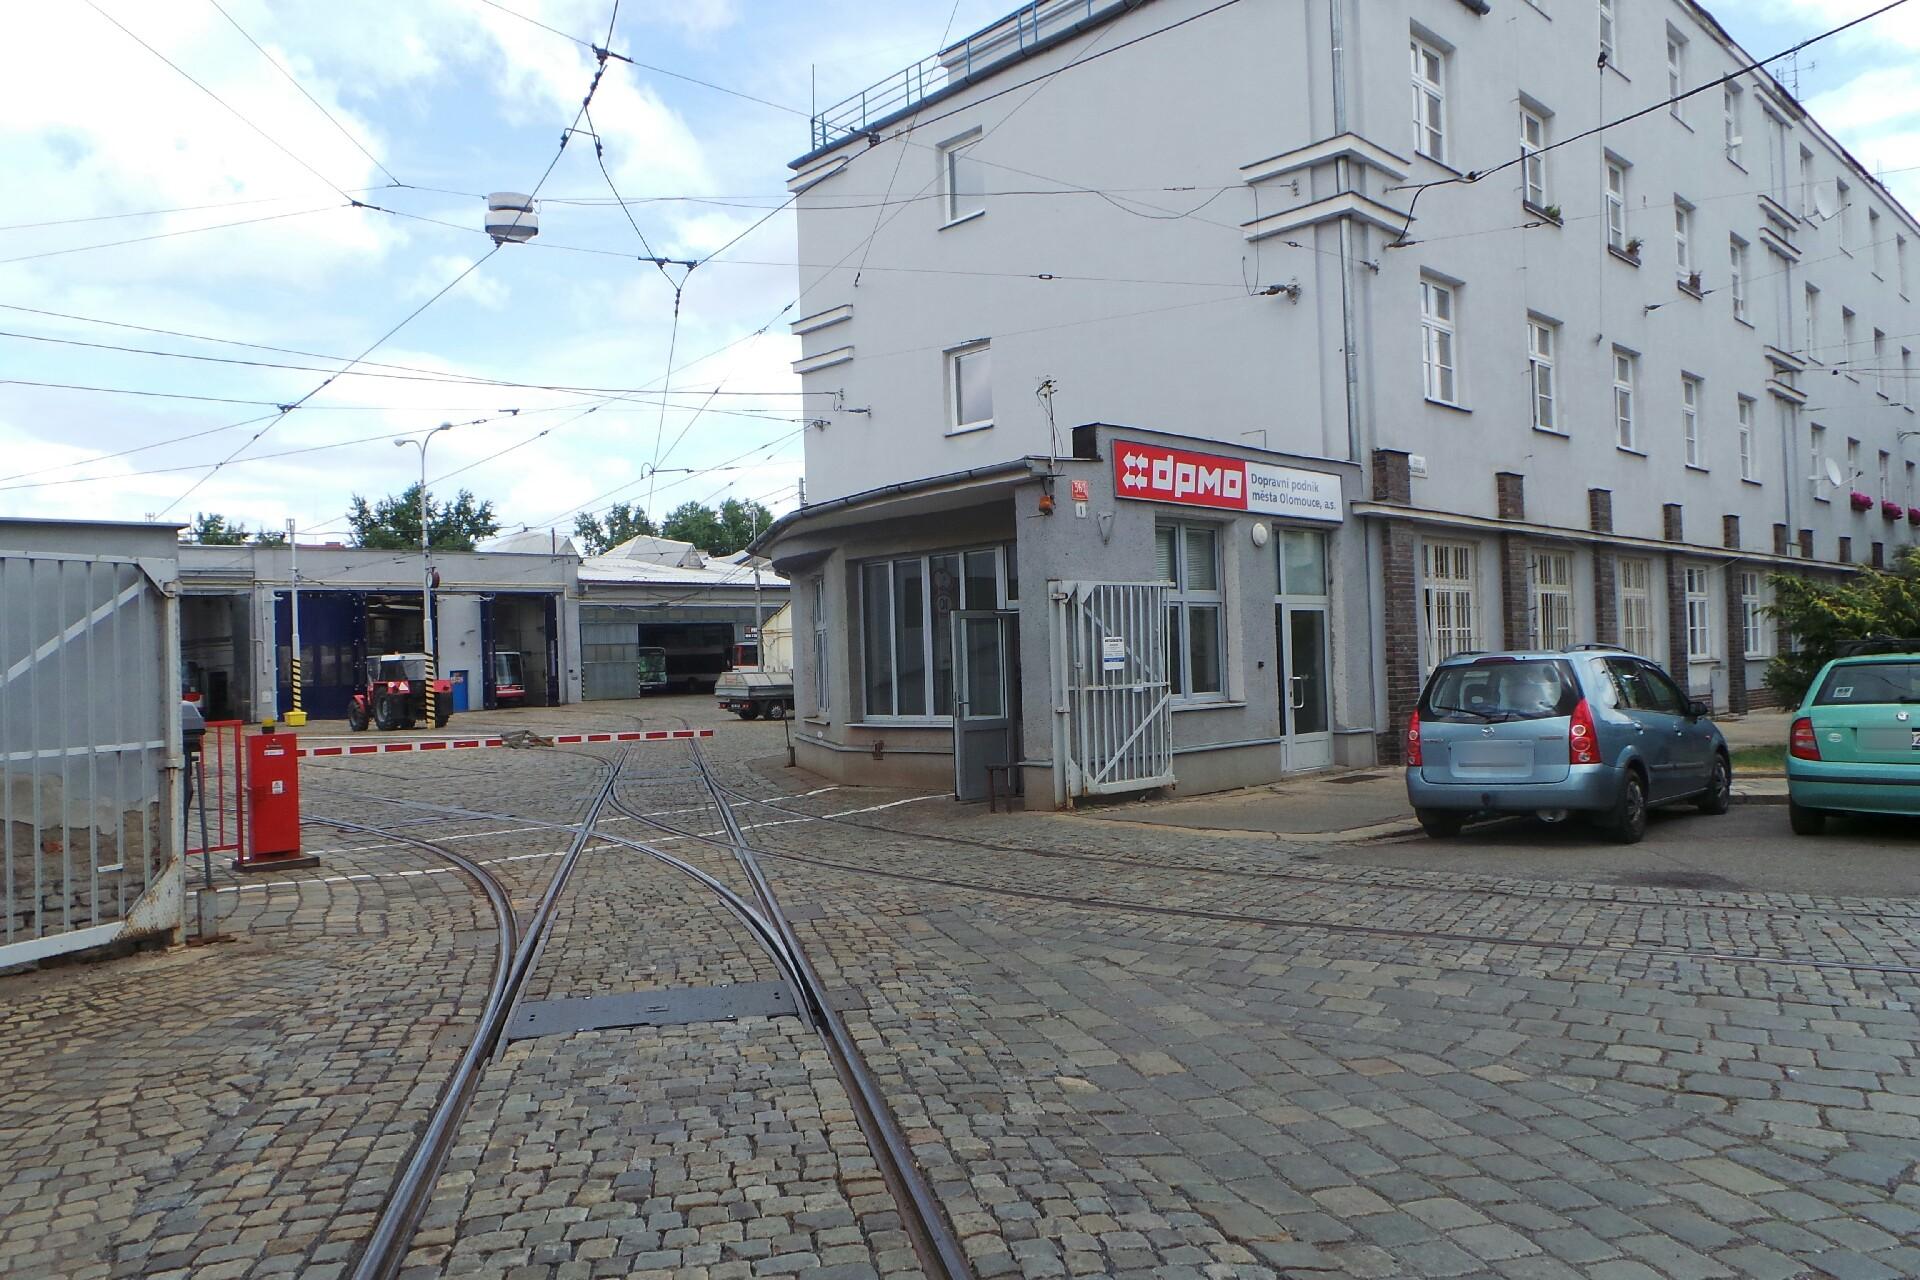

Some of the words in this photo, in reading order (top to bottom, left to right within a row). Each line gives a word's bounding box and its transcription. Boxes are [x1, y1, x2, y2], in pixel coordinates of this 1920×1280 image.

[1291, 479, 1320, 492] podnik
[1252, 490, 1278, 503] města
[1280, 492, 1322, 509] Olomouce,
